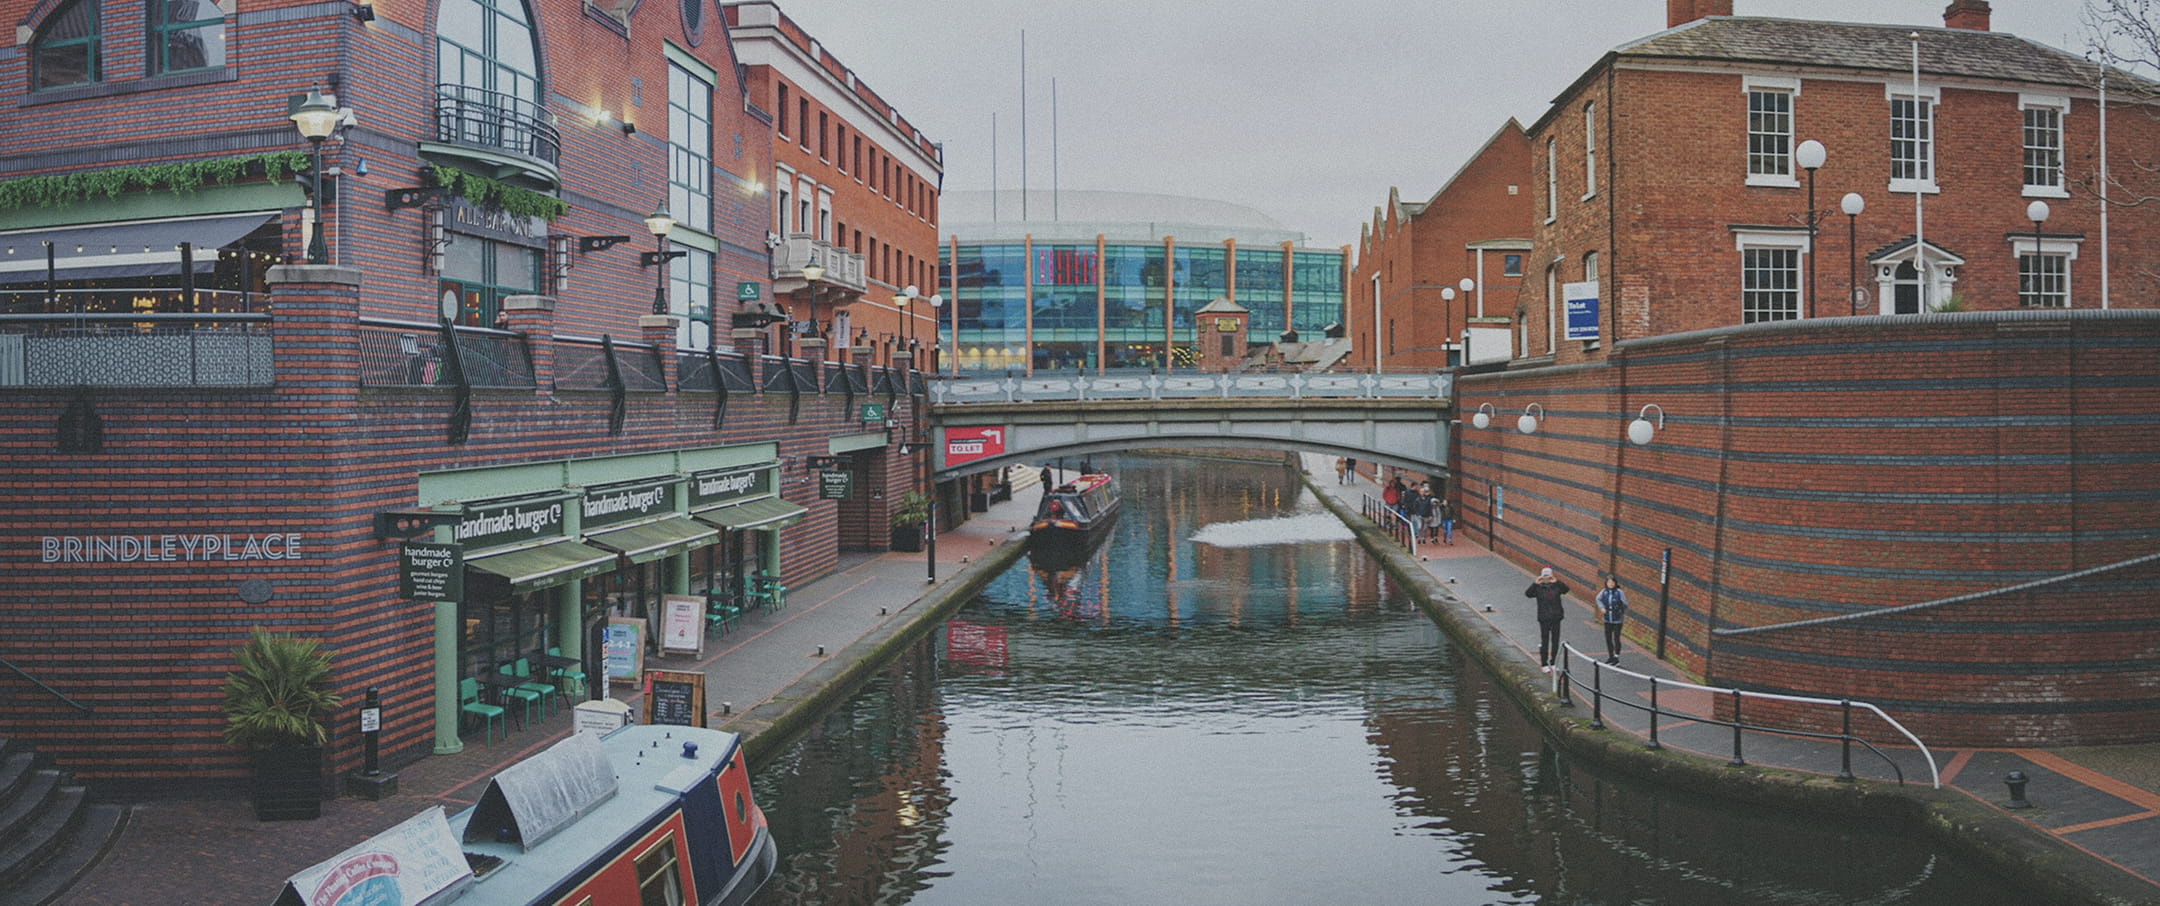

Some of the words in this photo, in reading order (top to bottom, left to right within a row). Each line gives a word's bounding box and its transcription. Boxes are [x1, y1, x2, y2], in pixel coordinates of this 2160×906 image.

[457, 206, 480, 226] ALL
[485, 210, 505, 232] BAR
[964, 445, 981, 453] LET
[699, 476, 731, 496] handmade
[730, 475, 748, 495] burger
[583, 492, 628, 518] handmade
[628, 490, 655, 513] burger
[515, 506, 549, 534] burger
[42, 533, 302, 563] BRINDLEYPLACE
[404, 546, 451, 558] handmade
[411, 556, 441, 569] burger
